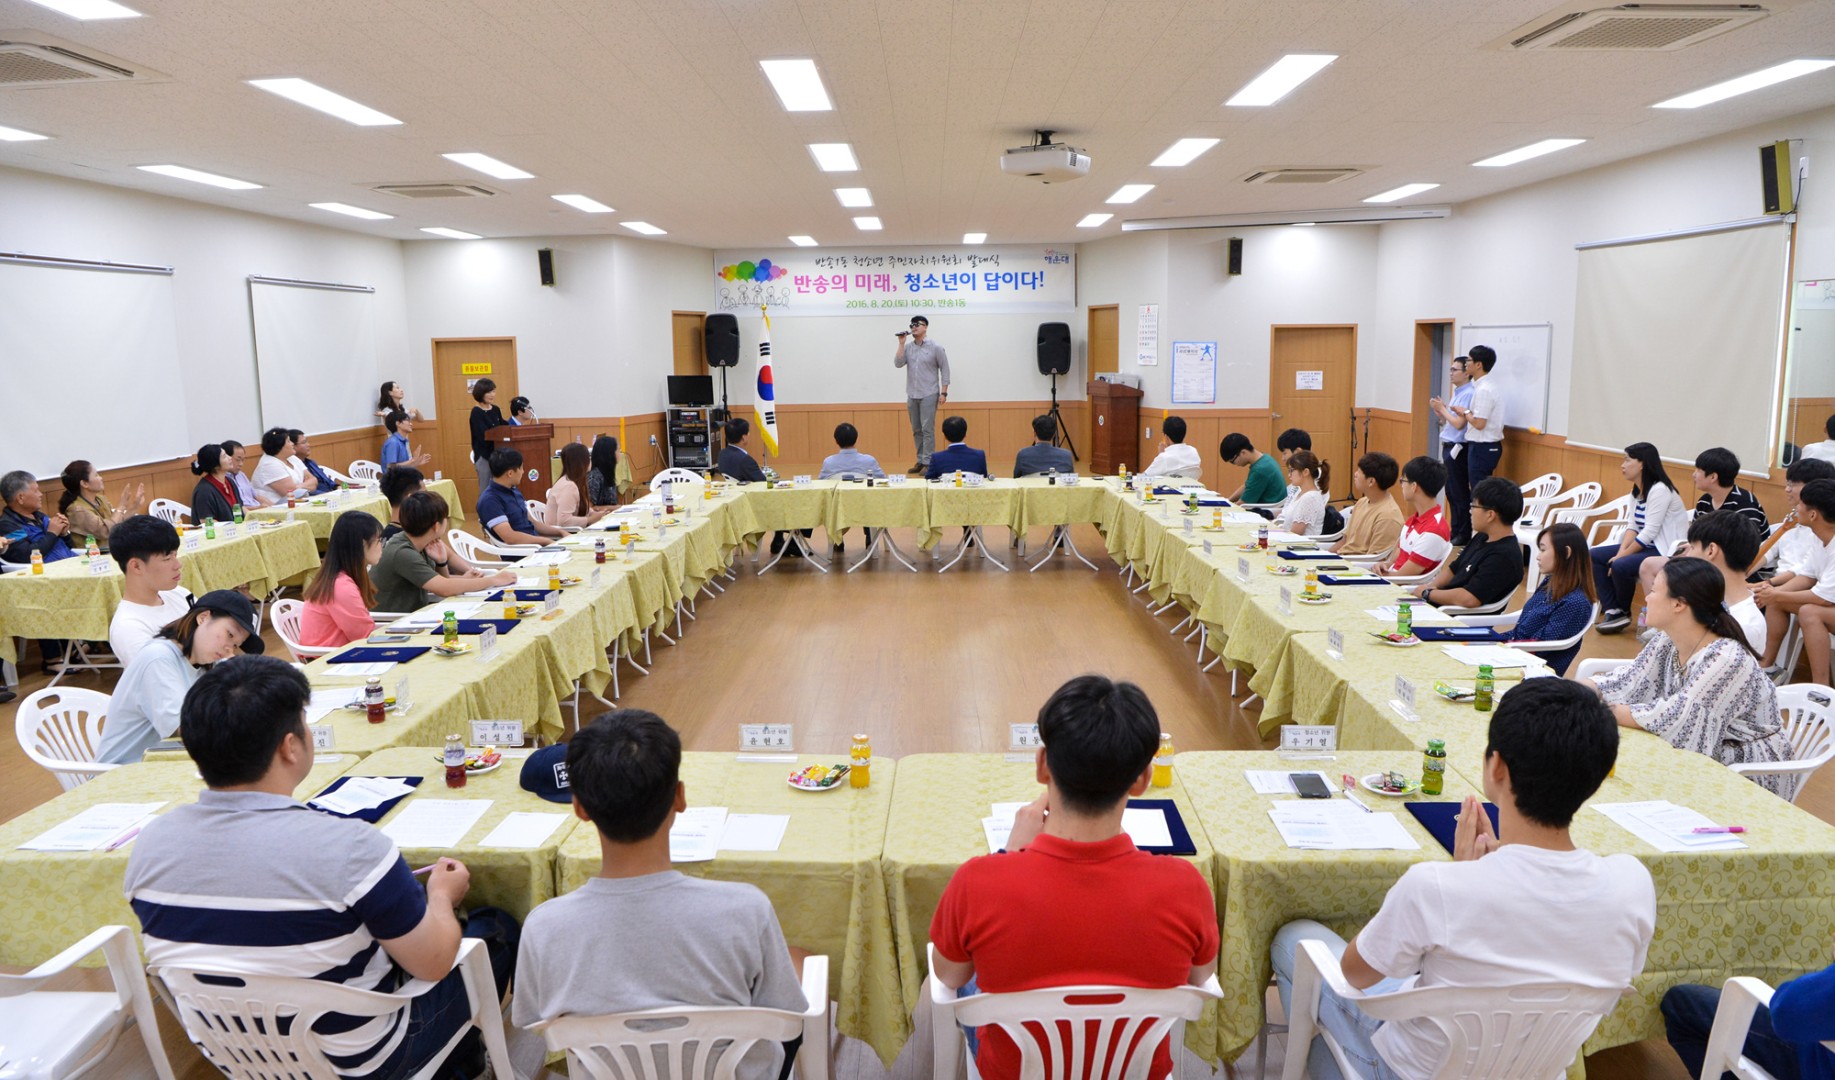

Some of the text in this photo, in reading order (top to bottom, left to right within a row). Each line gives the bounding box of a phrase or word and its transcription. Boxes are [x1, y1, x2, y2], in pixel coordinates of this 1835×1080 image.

[814, 254, 1000, 269] 반송1동 청소년 주민자치위원회 발대식
[794, 270, 1044, 294] 반송의 미래, 청소년이 답이다!
[846, 300, 869, 309] 2016.
[871, 300, 880, 309] 8.
[938, 298, 966, 308] 반송1동
